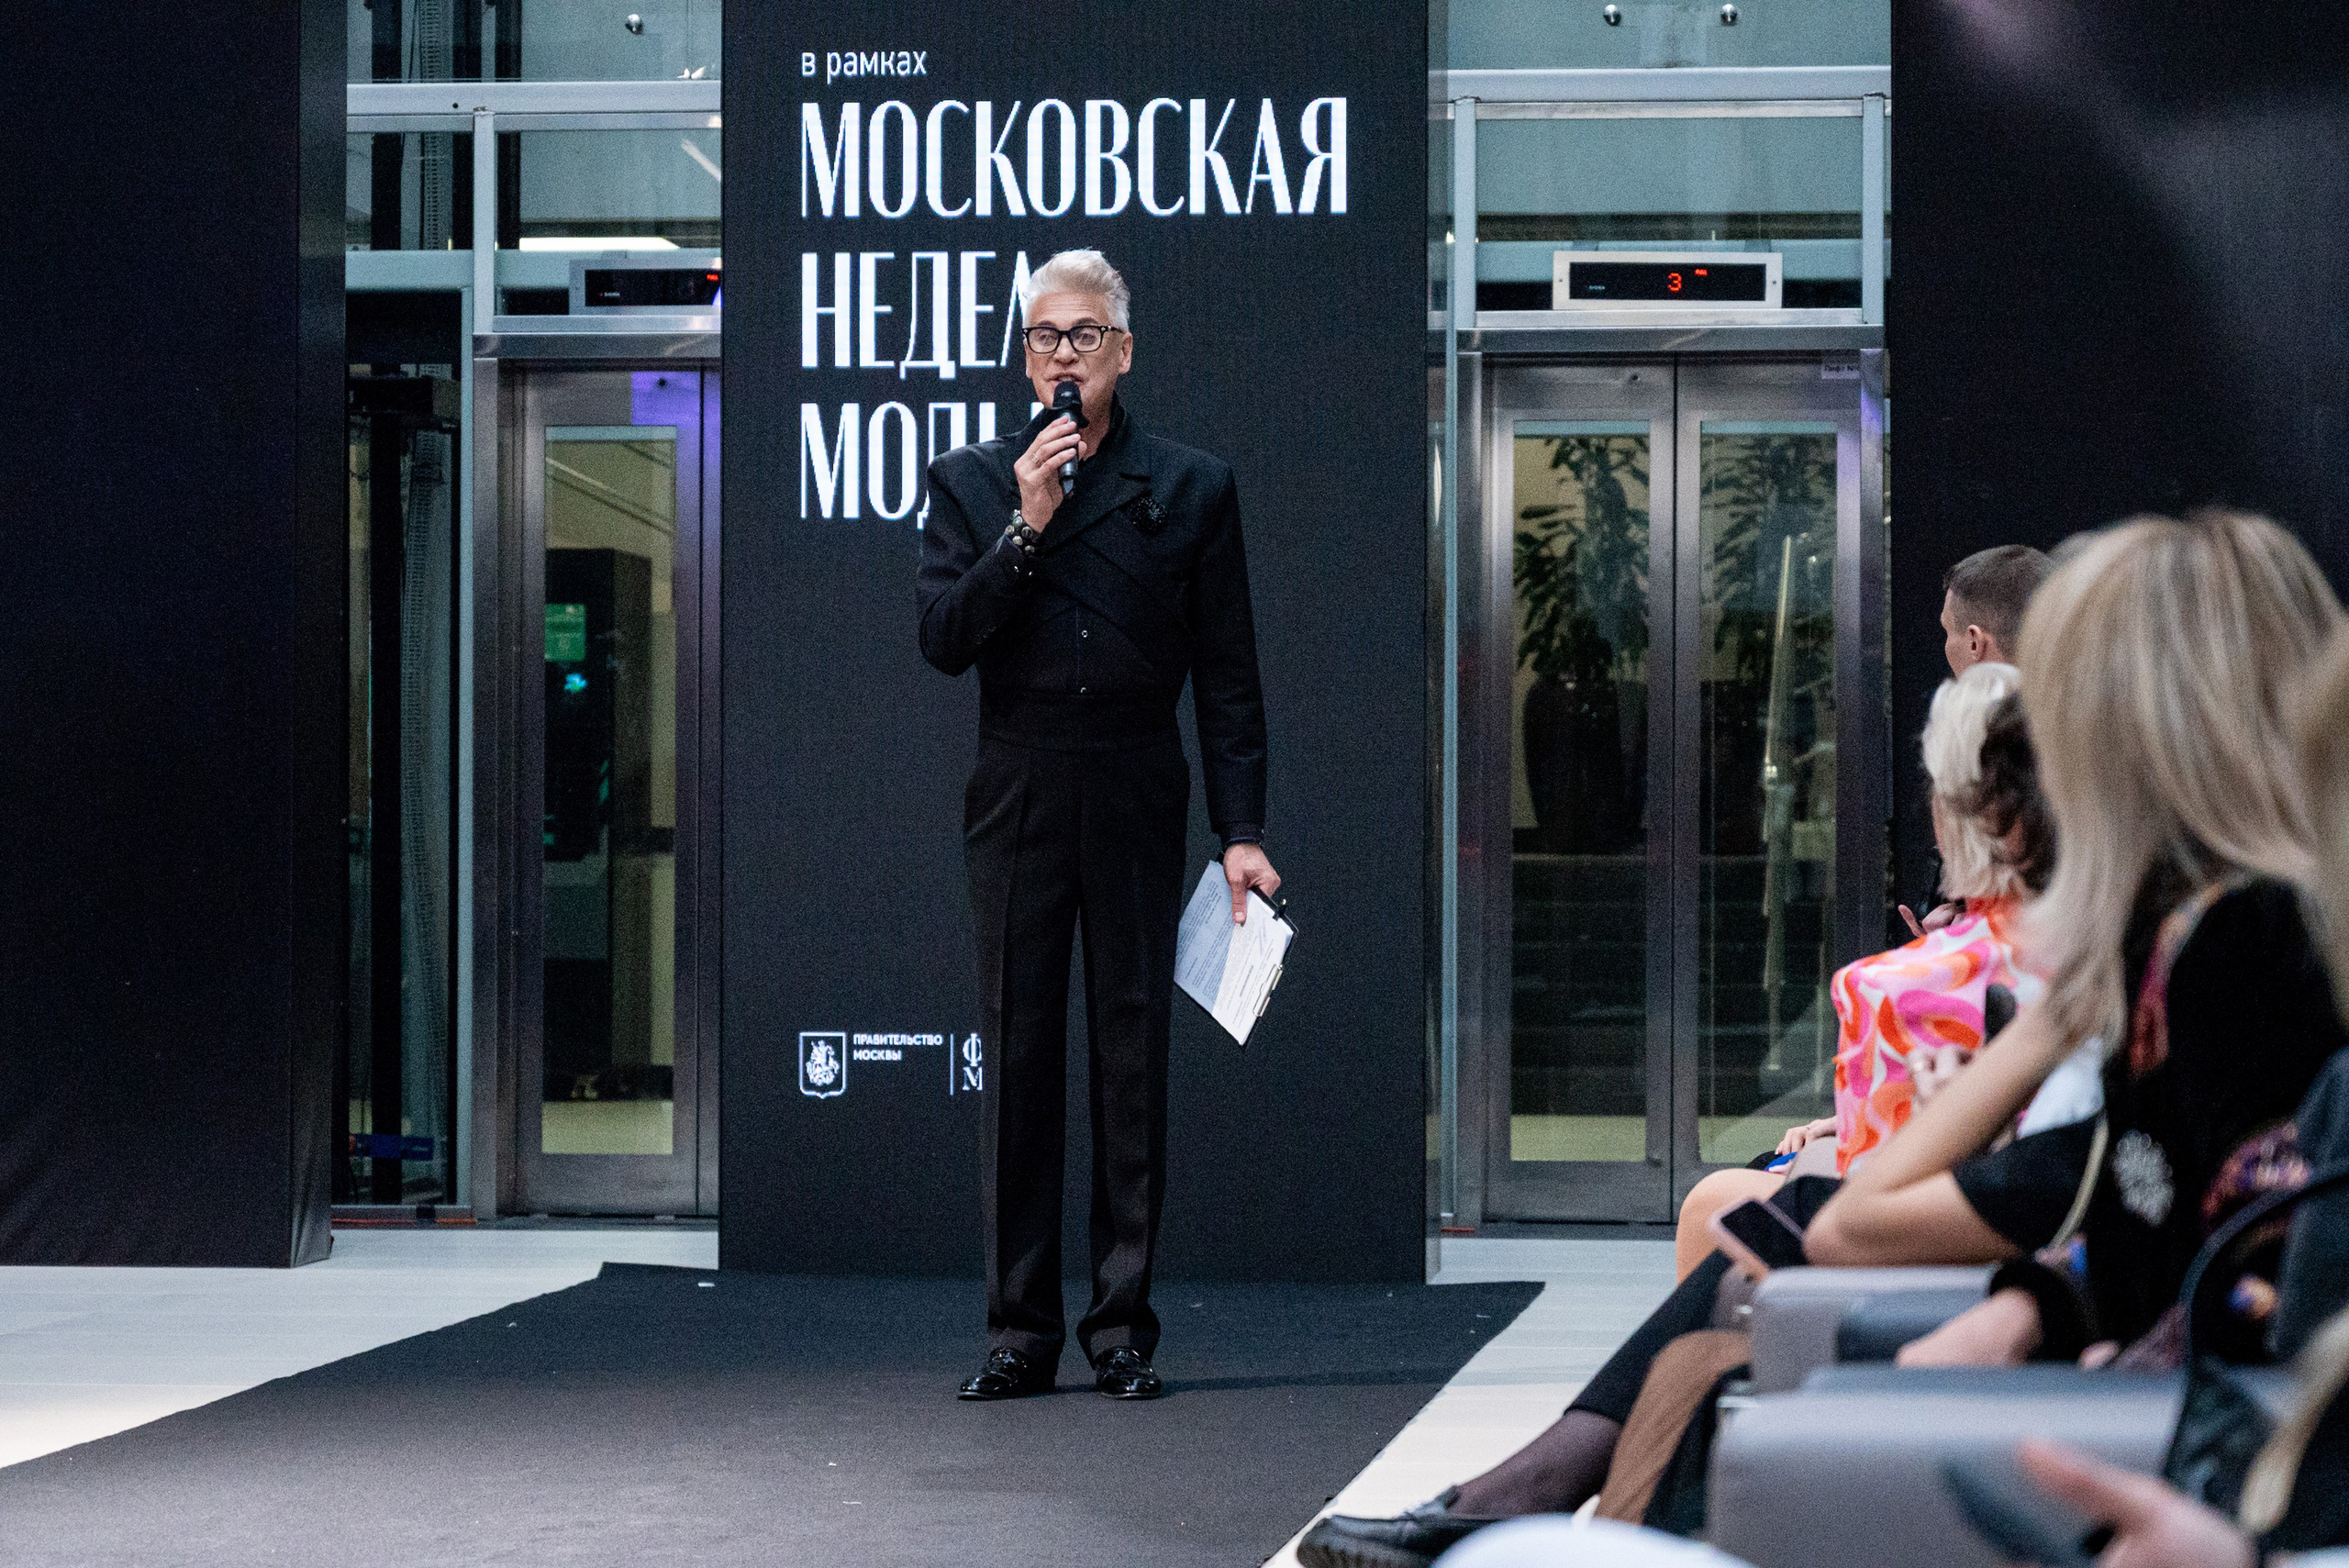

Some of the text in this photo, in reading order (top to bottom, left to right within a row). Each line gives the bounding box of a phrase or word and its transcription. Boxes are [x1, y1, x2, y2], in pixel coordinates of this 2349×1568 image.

[801, 50, 928, 84] в рамках
[801, 97, 1348, 218] МОСКОВСКАЯ
[1667, 272, 1683, 292] 3
[801, 250, 1030, 380] НЕДЕЛ
[853, 1033, 943, 1046] ПРАВИТЕЛЬСТВО
[853, 1049, 902, 1062] МОСКВЫ
